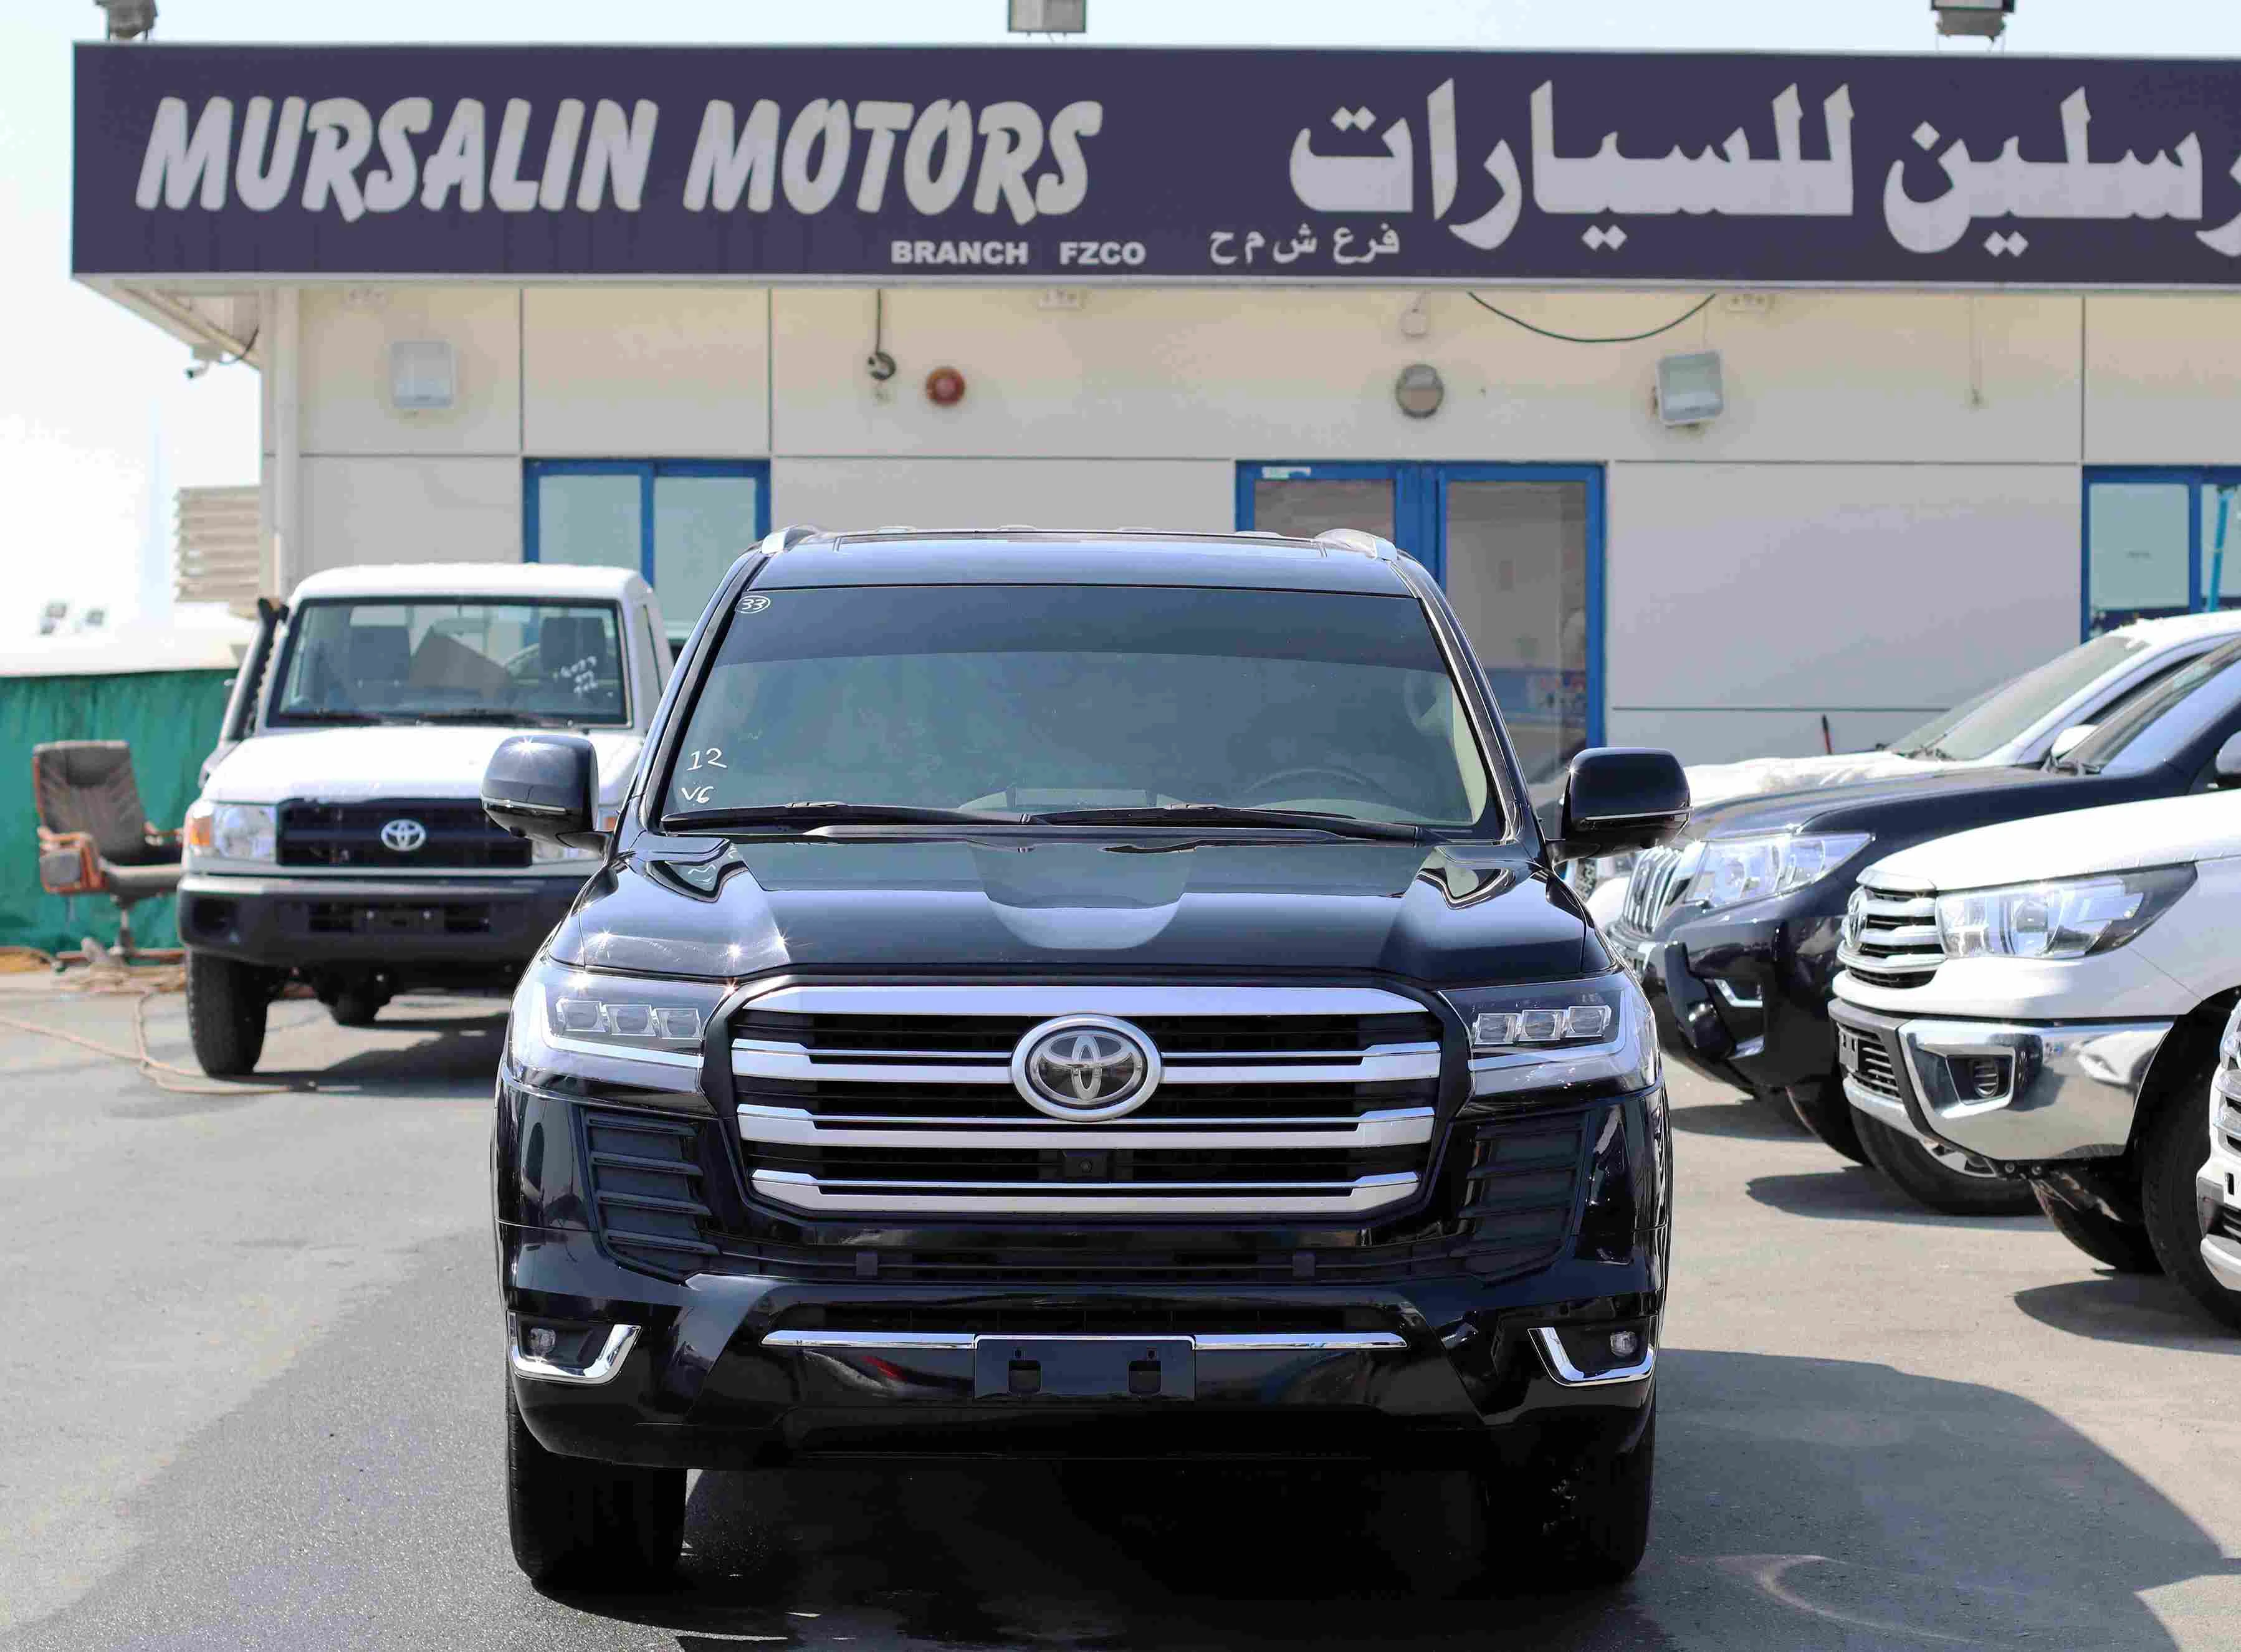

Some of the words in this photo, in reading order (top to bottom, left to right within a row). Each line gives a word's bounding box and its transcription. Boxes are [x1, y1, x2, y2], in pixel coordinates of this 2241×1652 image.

[135, 96, 659, 223] MURSALIN
[682, 98, 1103, 226] MOTORS
[1289, 78, 1855, 251] للسيارات
[891, 240, 1029, 265] BRANCH
[1059, 241, 1147, 265] FZCO
[1332, 222, 1400, 265] فرع
[686, 747, 728, 771] 12
